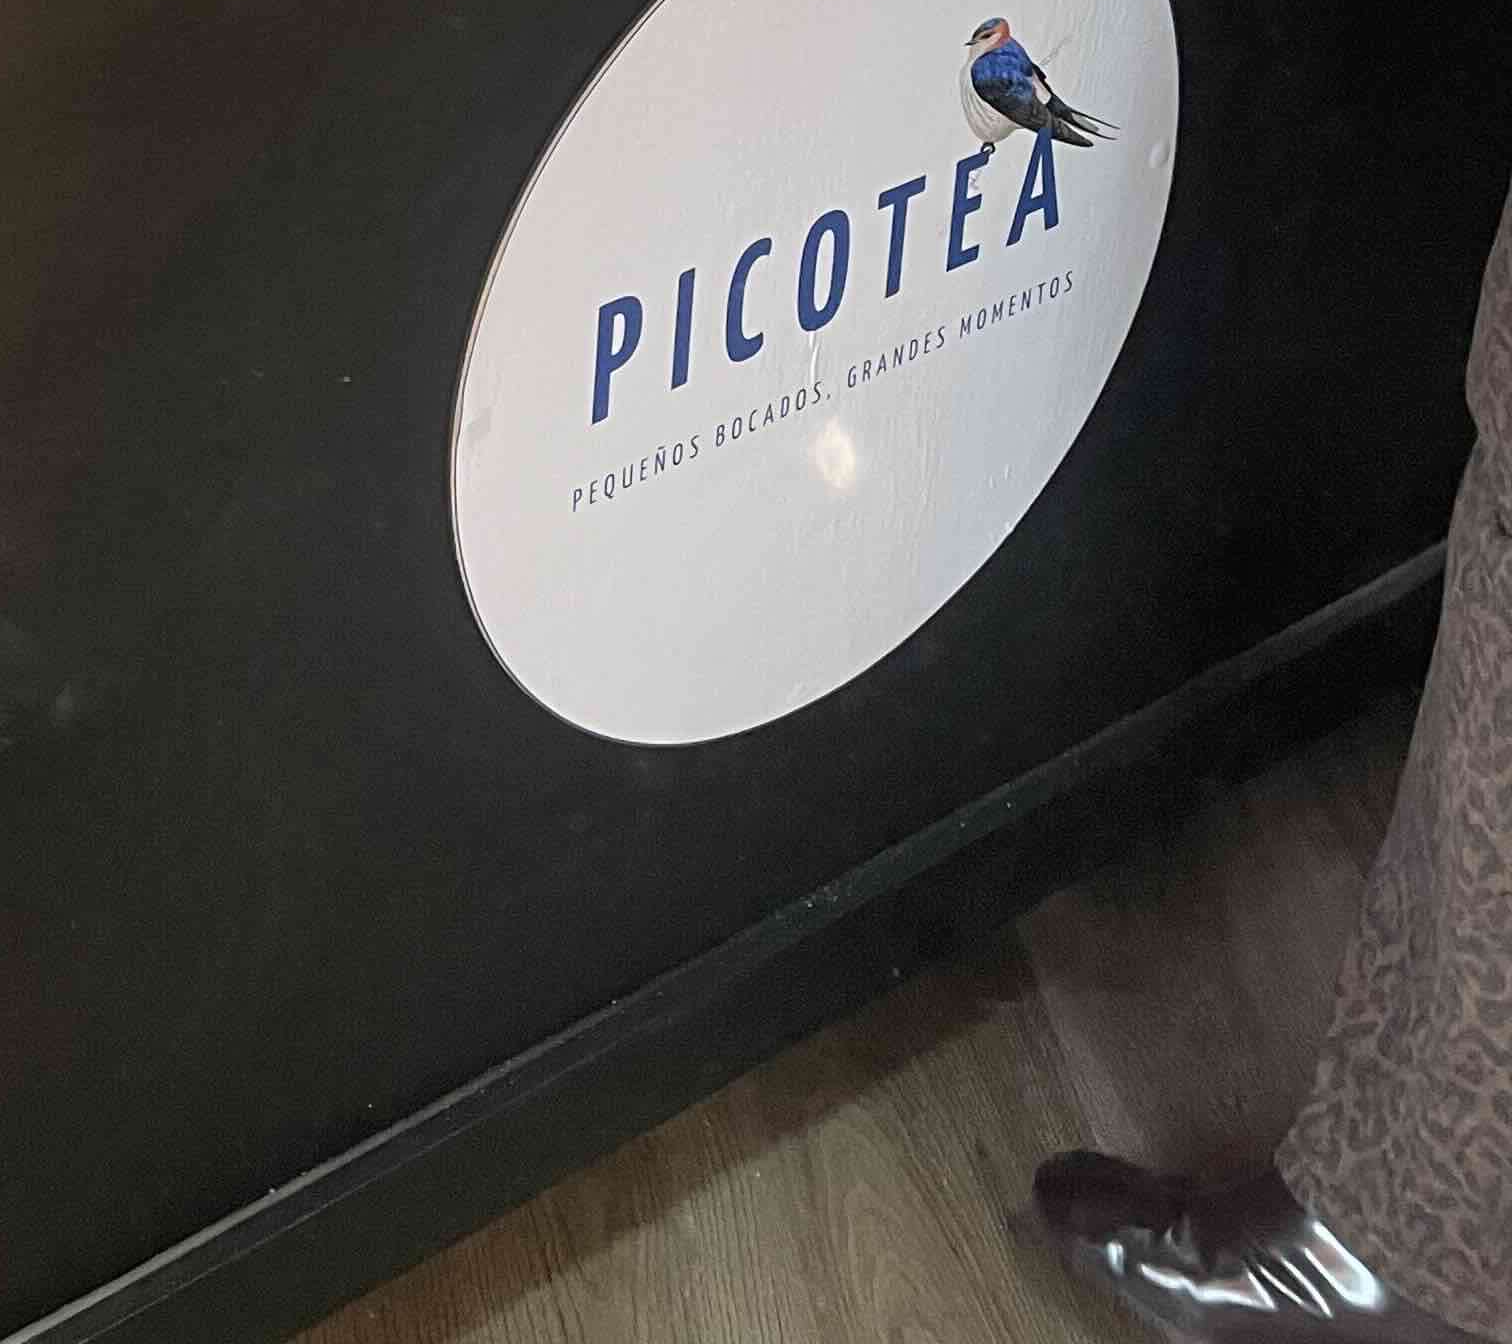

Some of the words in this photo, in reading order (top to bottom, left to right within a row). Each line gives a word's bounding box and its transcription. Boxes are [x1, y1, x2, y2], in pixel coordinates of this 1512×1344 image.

[572, 435, 701, 513] PEQUEÑOS
[715, 381, 832, 448] BOCADOS,
[847, 325, 946, 389] GRANDES
[959, 269, 1074, 340] MOMENTOS
[591, 127, 1060, 426] PICOTEA
